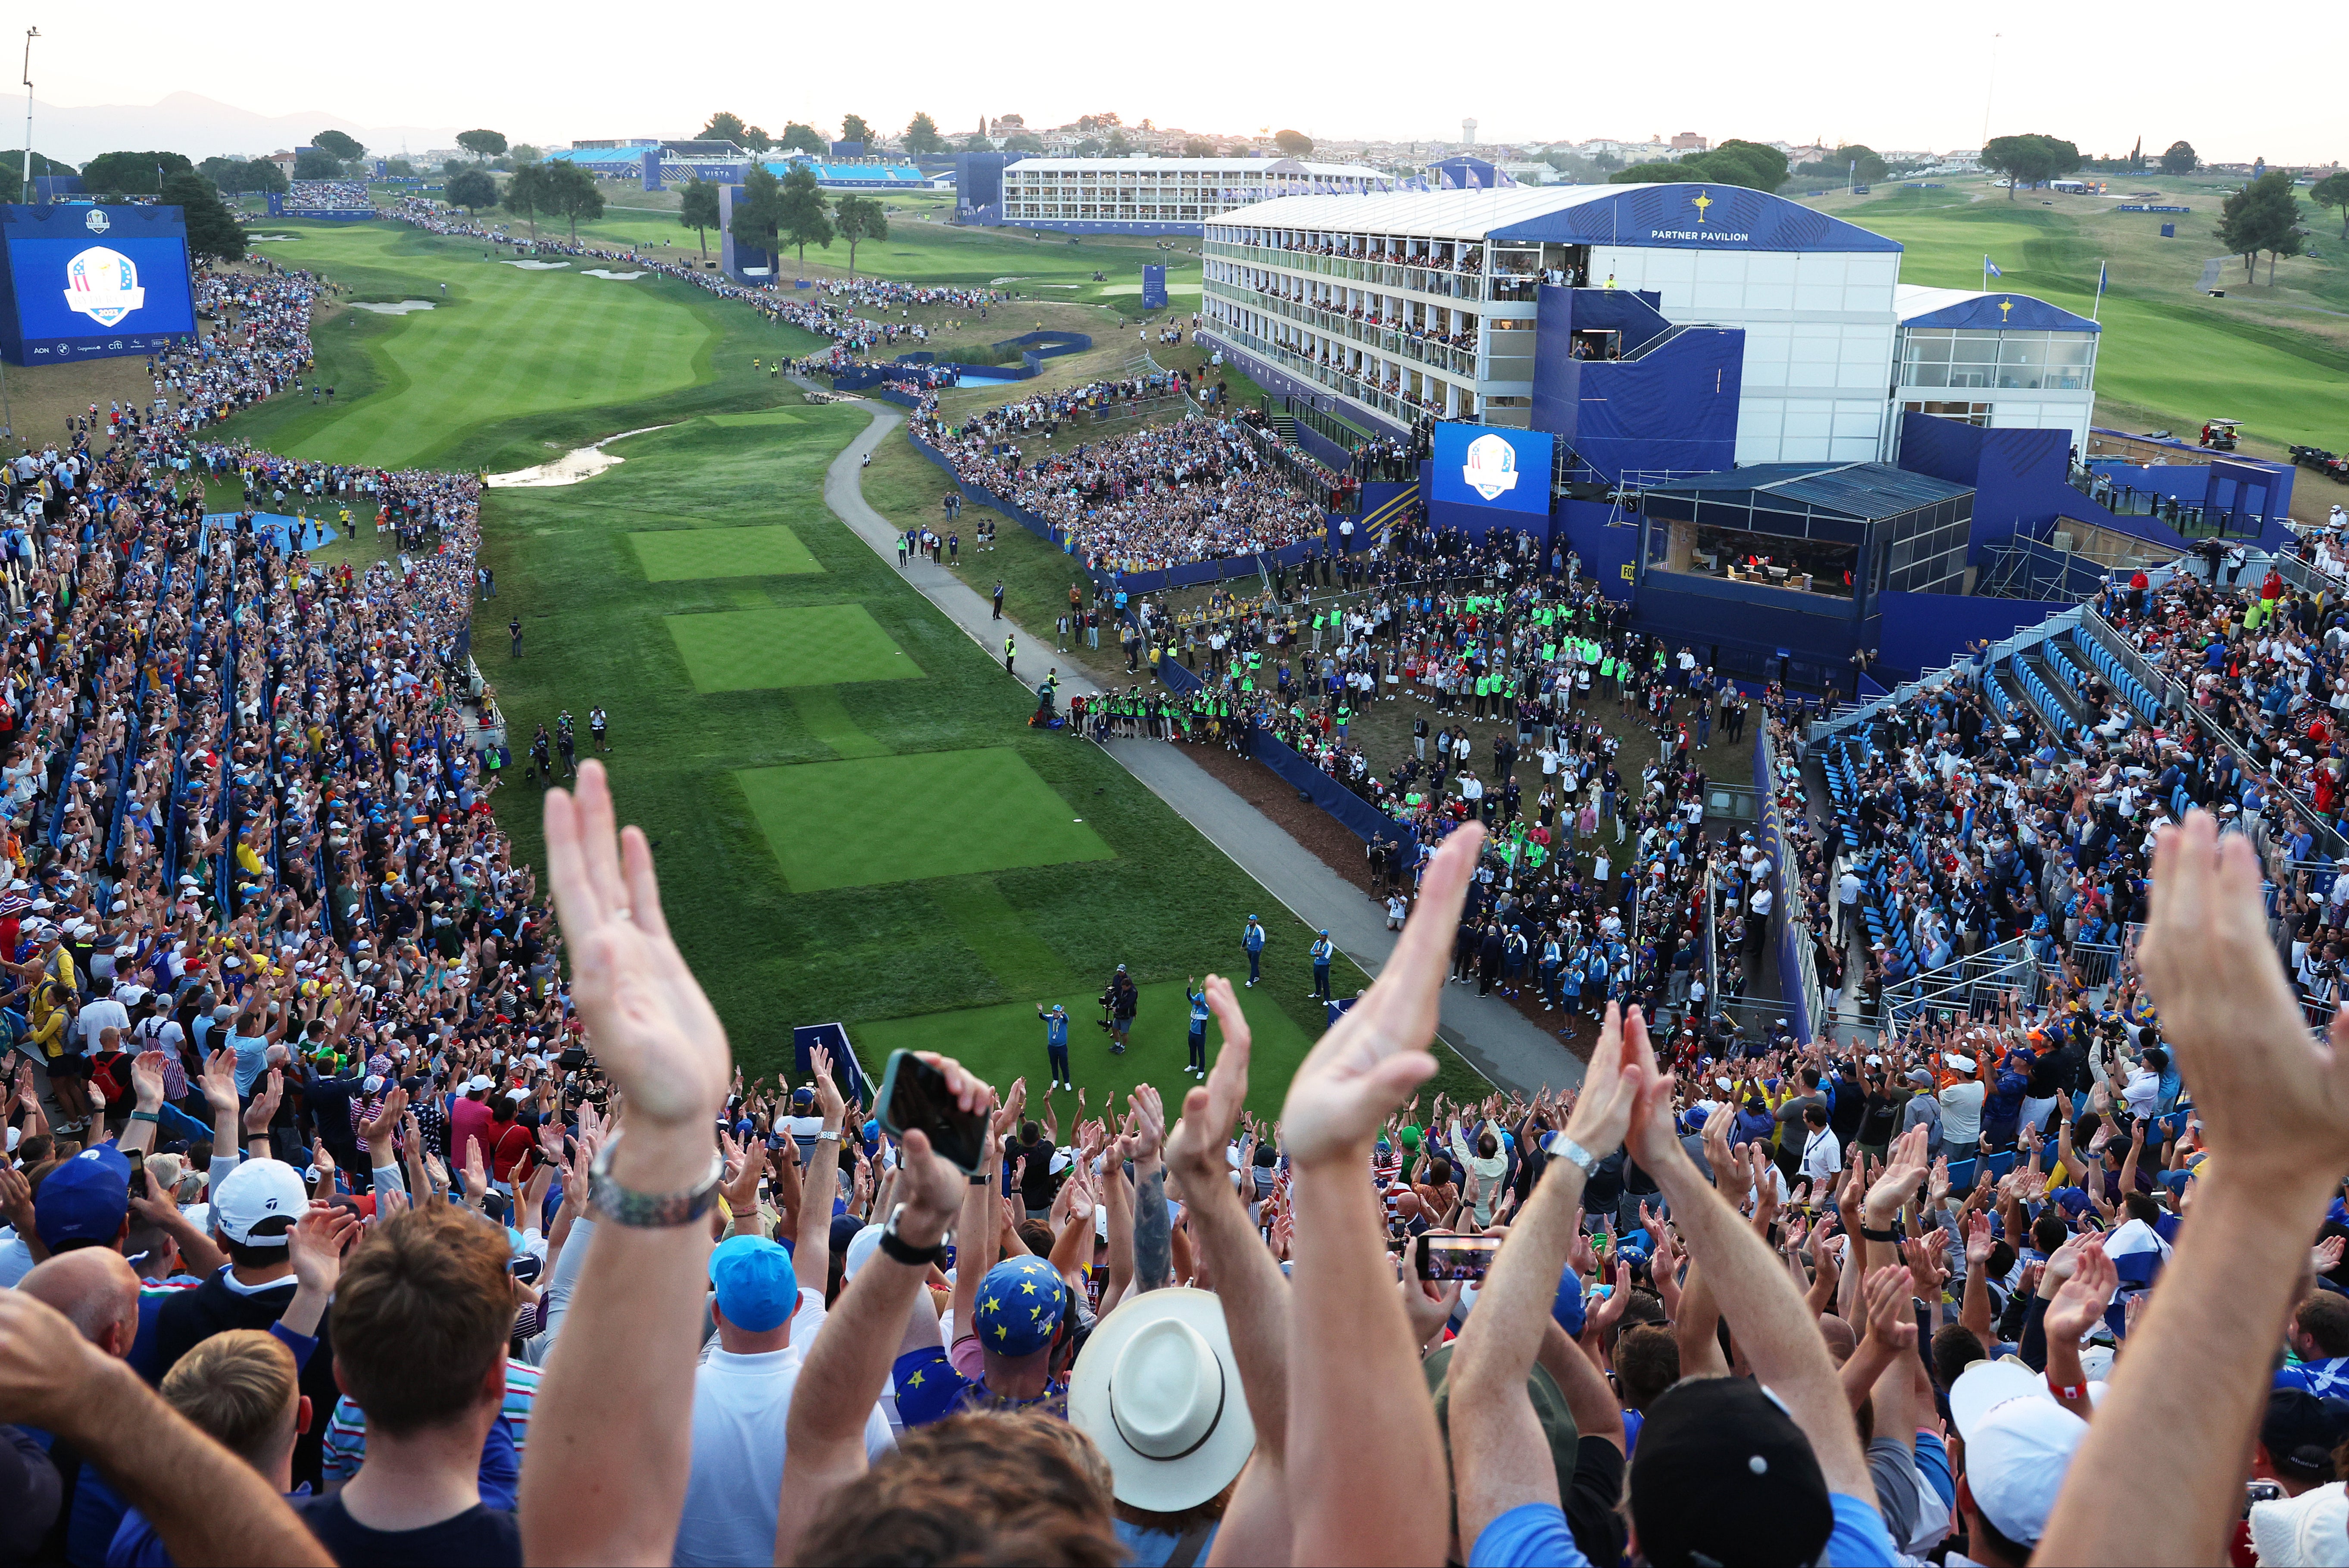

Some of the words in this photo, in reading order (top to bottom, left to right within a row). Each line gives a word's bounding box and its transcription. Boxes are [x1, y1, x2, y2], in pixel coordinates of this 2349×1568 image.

[1652, 230, 1698, 240] PARTNER
[1701, 232, 1749, 241] PAVILION
[98, 309, 119, 317] 2023
[108, 341, 122, 350] citi
[2290, 1456, 2318, 1468] abacus
